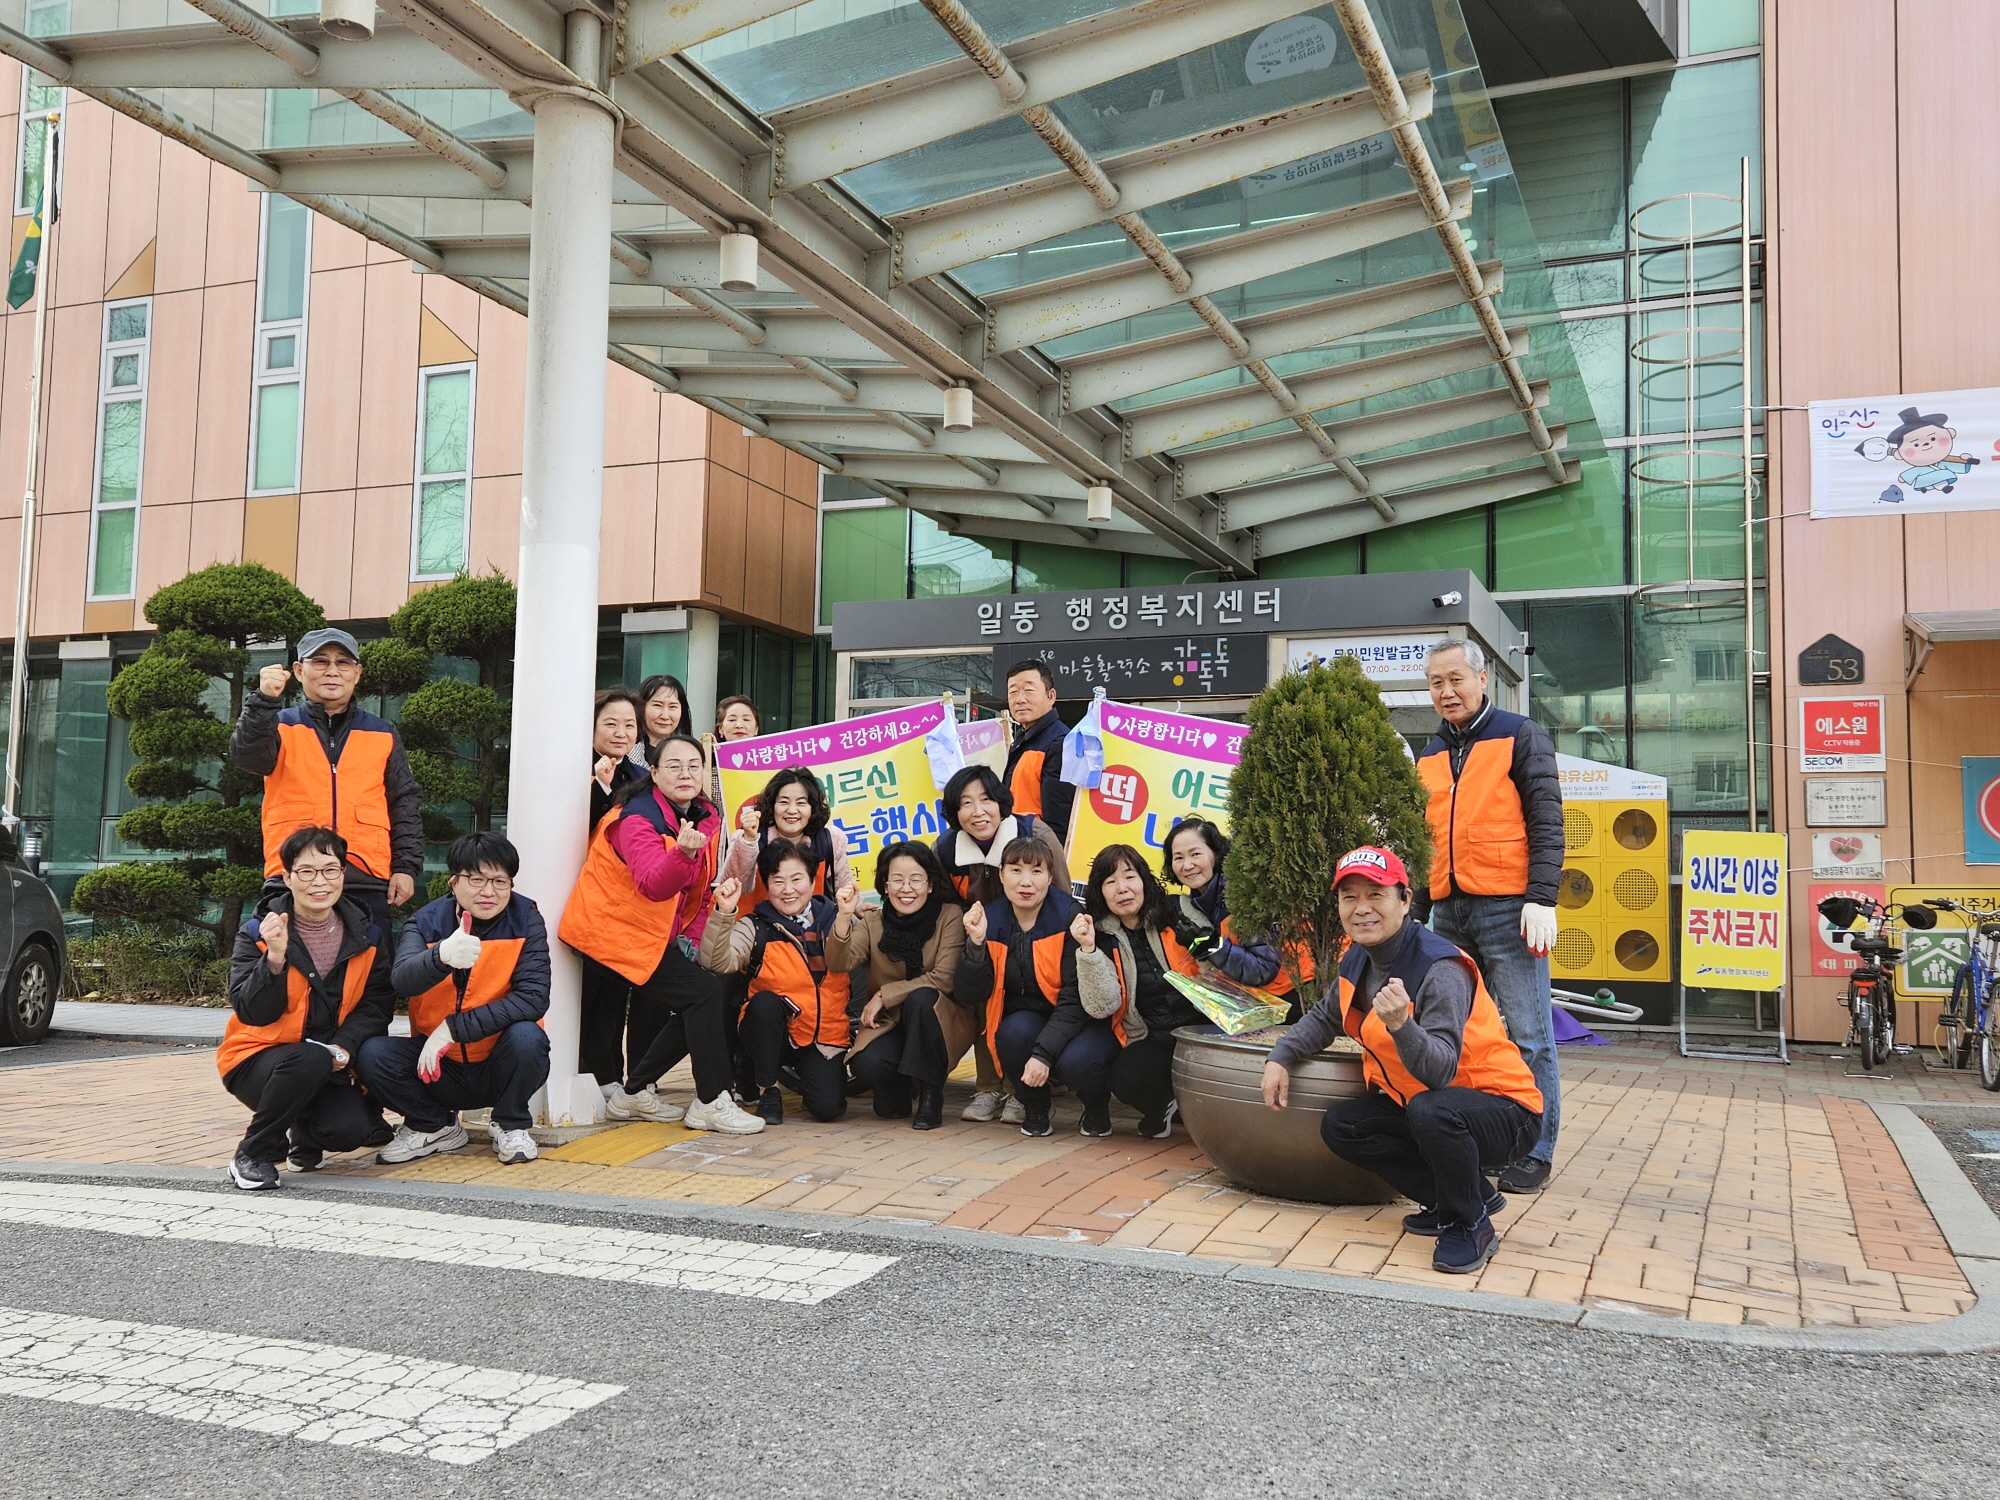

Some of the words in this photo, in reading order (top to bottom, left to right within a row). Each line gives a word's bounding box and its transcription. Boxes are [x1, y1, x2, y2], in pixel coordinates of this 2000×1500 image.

[977, 601, 1040, 635] 일동
[1065, 587, 1280, 632] 행정복지센터
[1059, 653, 1151, 682] 마을활력소
[1366, 665, 1390, 674] 07:00
[1401, 664, 1424, 672] 22:00
[1827, 658, 1859, 681] 53
[1120, 716, 1201, 748] 사랑합니다
[1815, 716, 1868, 735] 에스원
[745, 738, 818, 767] 사랑합니다
[1805, 757, 1843, 766] SECOM
[1099, 772, 1138, 822] 떡
[1339, 851, 1388, 871] ARUBA
[1690, 856, 1738, 894] 3시간
[1743, 858, 1779, 896] 이상
[1688, 908, 1778, 949] 주차금지
